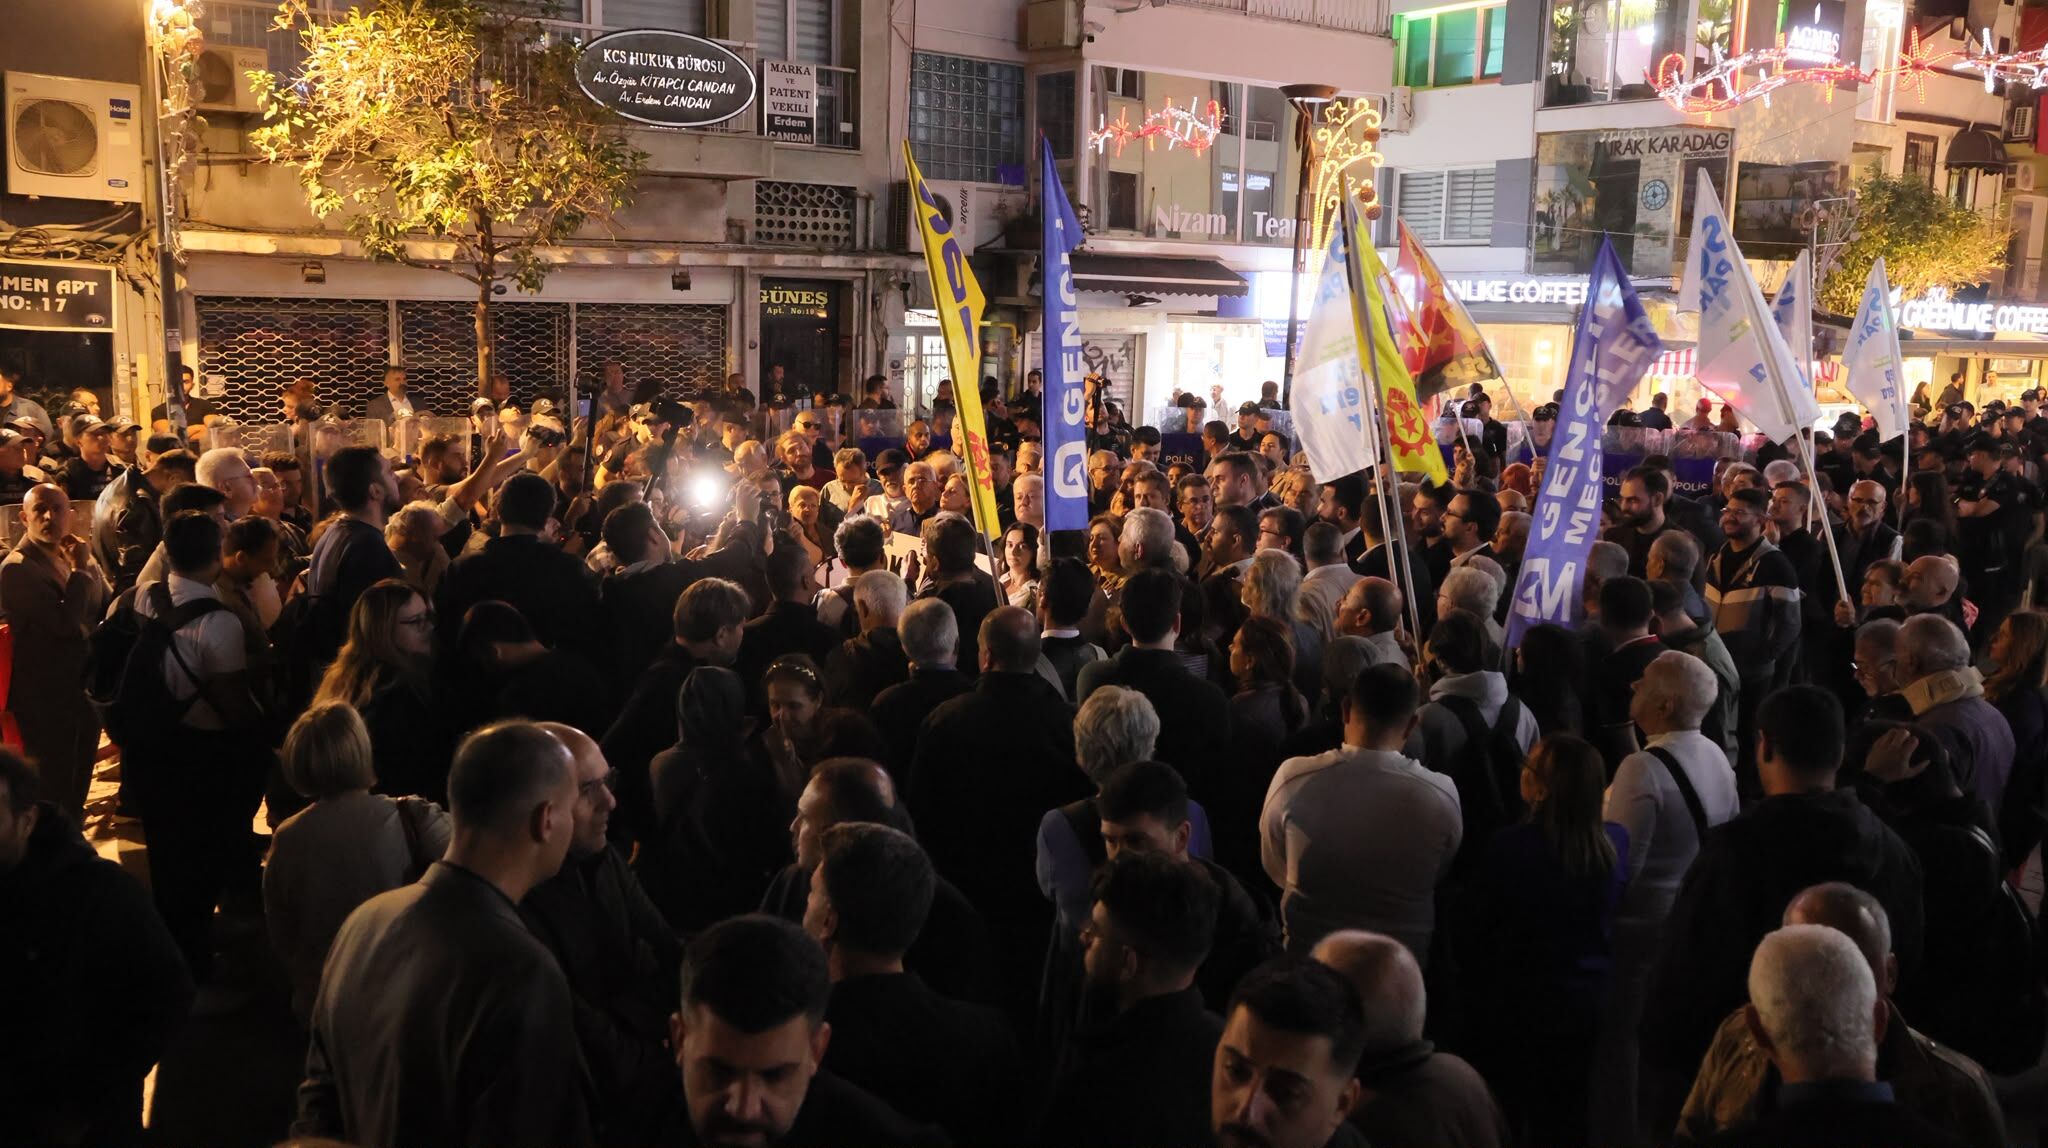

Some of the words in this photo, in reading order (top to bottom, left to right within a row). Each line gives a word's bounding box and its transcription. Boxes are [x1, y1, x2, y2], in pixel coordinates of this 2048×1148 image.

[1787, 25, 1840, 54] AGNES
[603, 49, 627, 64] KCS
[629, 51, 675, 69] HUKUK
[677, 54, 726, 74] BÜROSU
[770, 62, 811, 76] MARKA
[687, 79, 736, 95] CANDAN
[785, 77, 796, 85] VE
[769, 86, 812, 100] PATENT
[110, 105, 131, 114] Haier
[663, 94, 712, 110] CANDAN
[774, 116, 807, 128] Erdem
[769, 130, 812, 144] CANDAN
[960, 186, 969, 225] arçelik
[1155, 203, 1227, 235] Nizam
[0, 275, 49, 293] MEN
[55, 279, 99, 296] APT
[41, 297, 67, 313] 17
[760, 286, 829, 309] GÜNEŞ
[766, 306, 785, 315] Apt.
[1903, 301, 1994, 333] GREENLIKE
[1996, 305, 2048, 333] COFFEE
[1165, 453, 1194, 464] POLİS
[1601, 475, 1621, 486] POL
